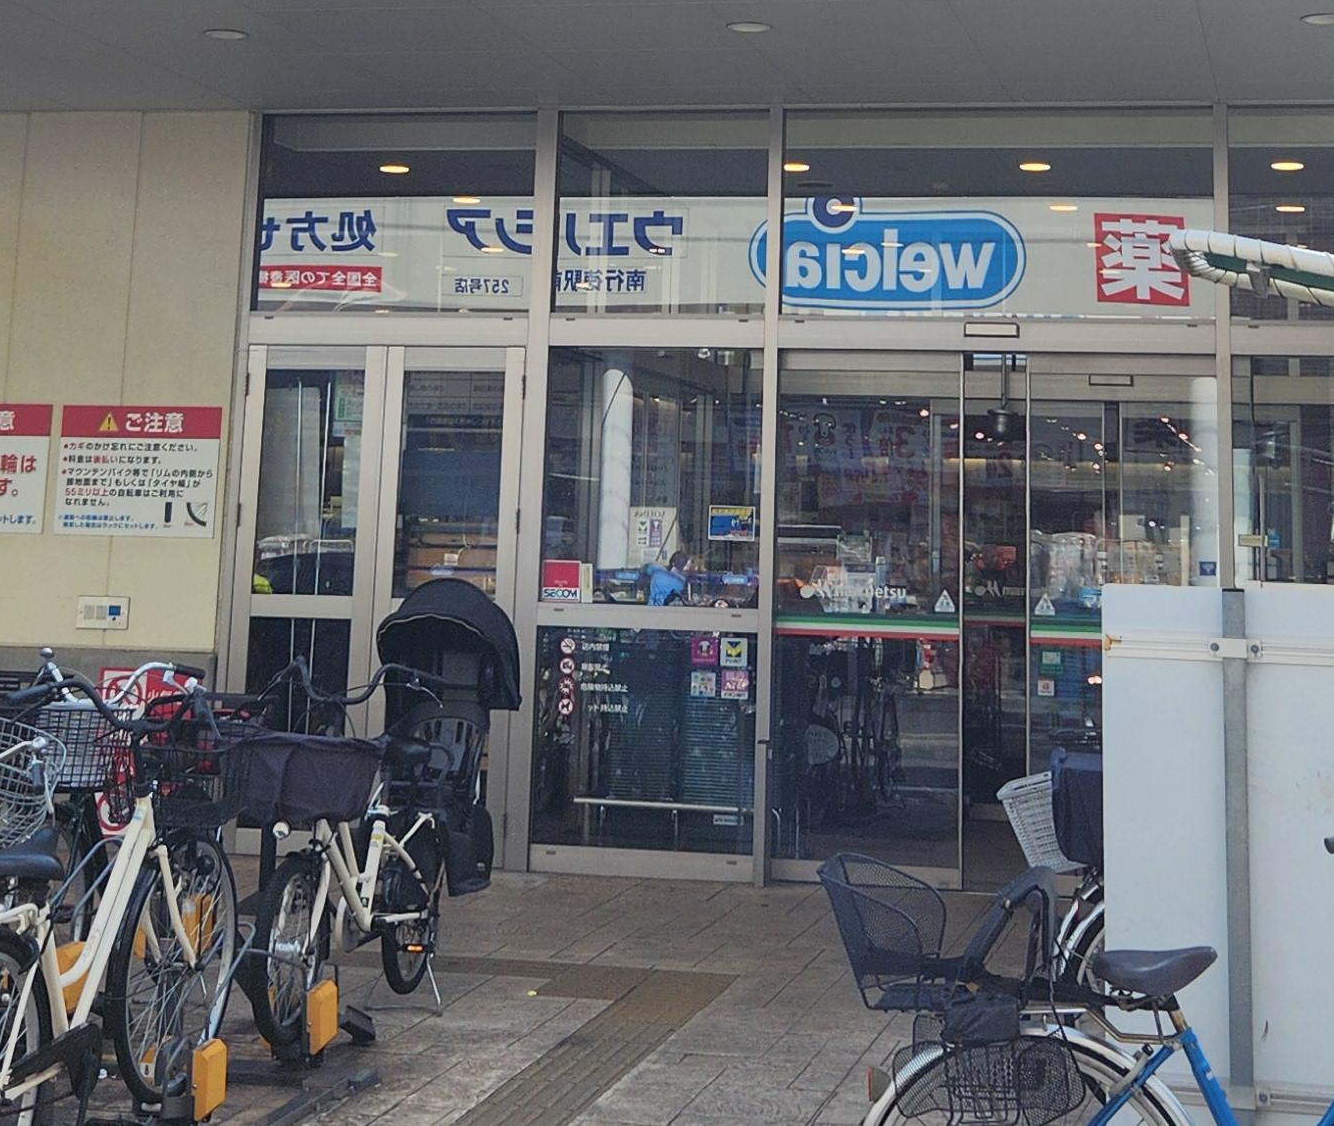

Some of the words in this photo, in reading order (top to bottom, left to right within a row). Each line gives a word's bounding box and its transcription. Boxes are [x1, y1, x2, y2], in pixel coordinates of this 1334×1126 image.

[125, 412, 184, 432] ご注意
[543, 587, 578, 599] SECOM
